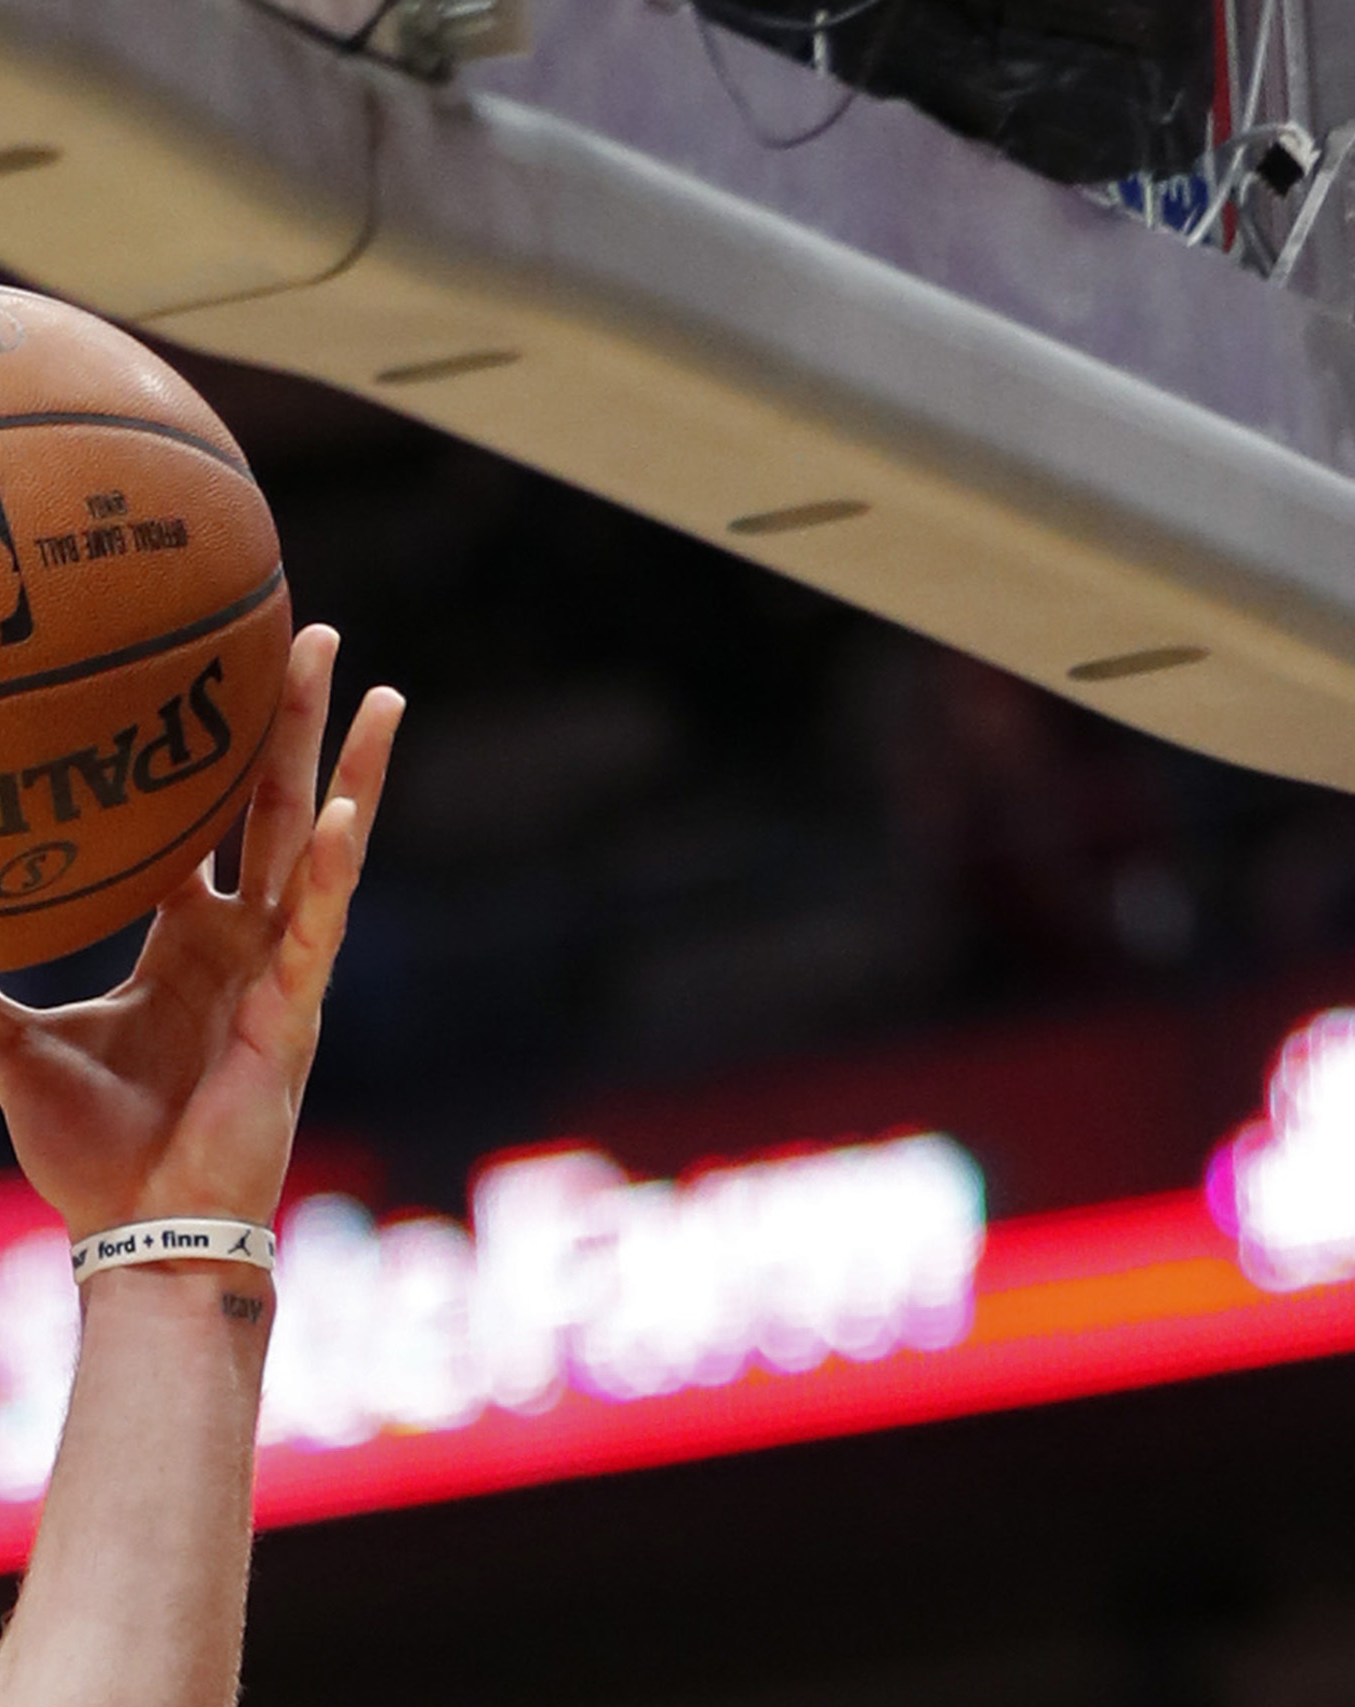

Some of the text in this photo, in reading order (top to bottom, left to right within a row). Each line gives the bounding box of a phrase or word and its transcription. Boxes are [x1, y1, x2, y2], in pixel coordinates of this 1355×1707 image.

[33, 533, 80, 568] BALL
[98, 1235, 137, 1260] ford
[161, 1230, 210, 1250] finn
